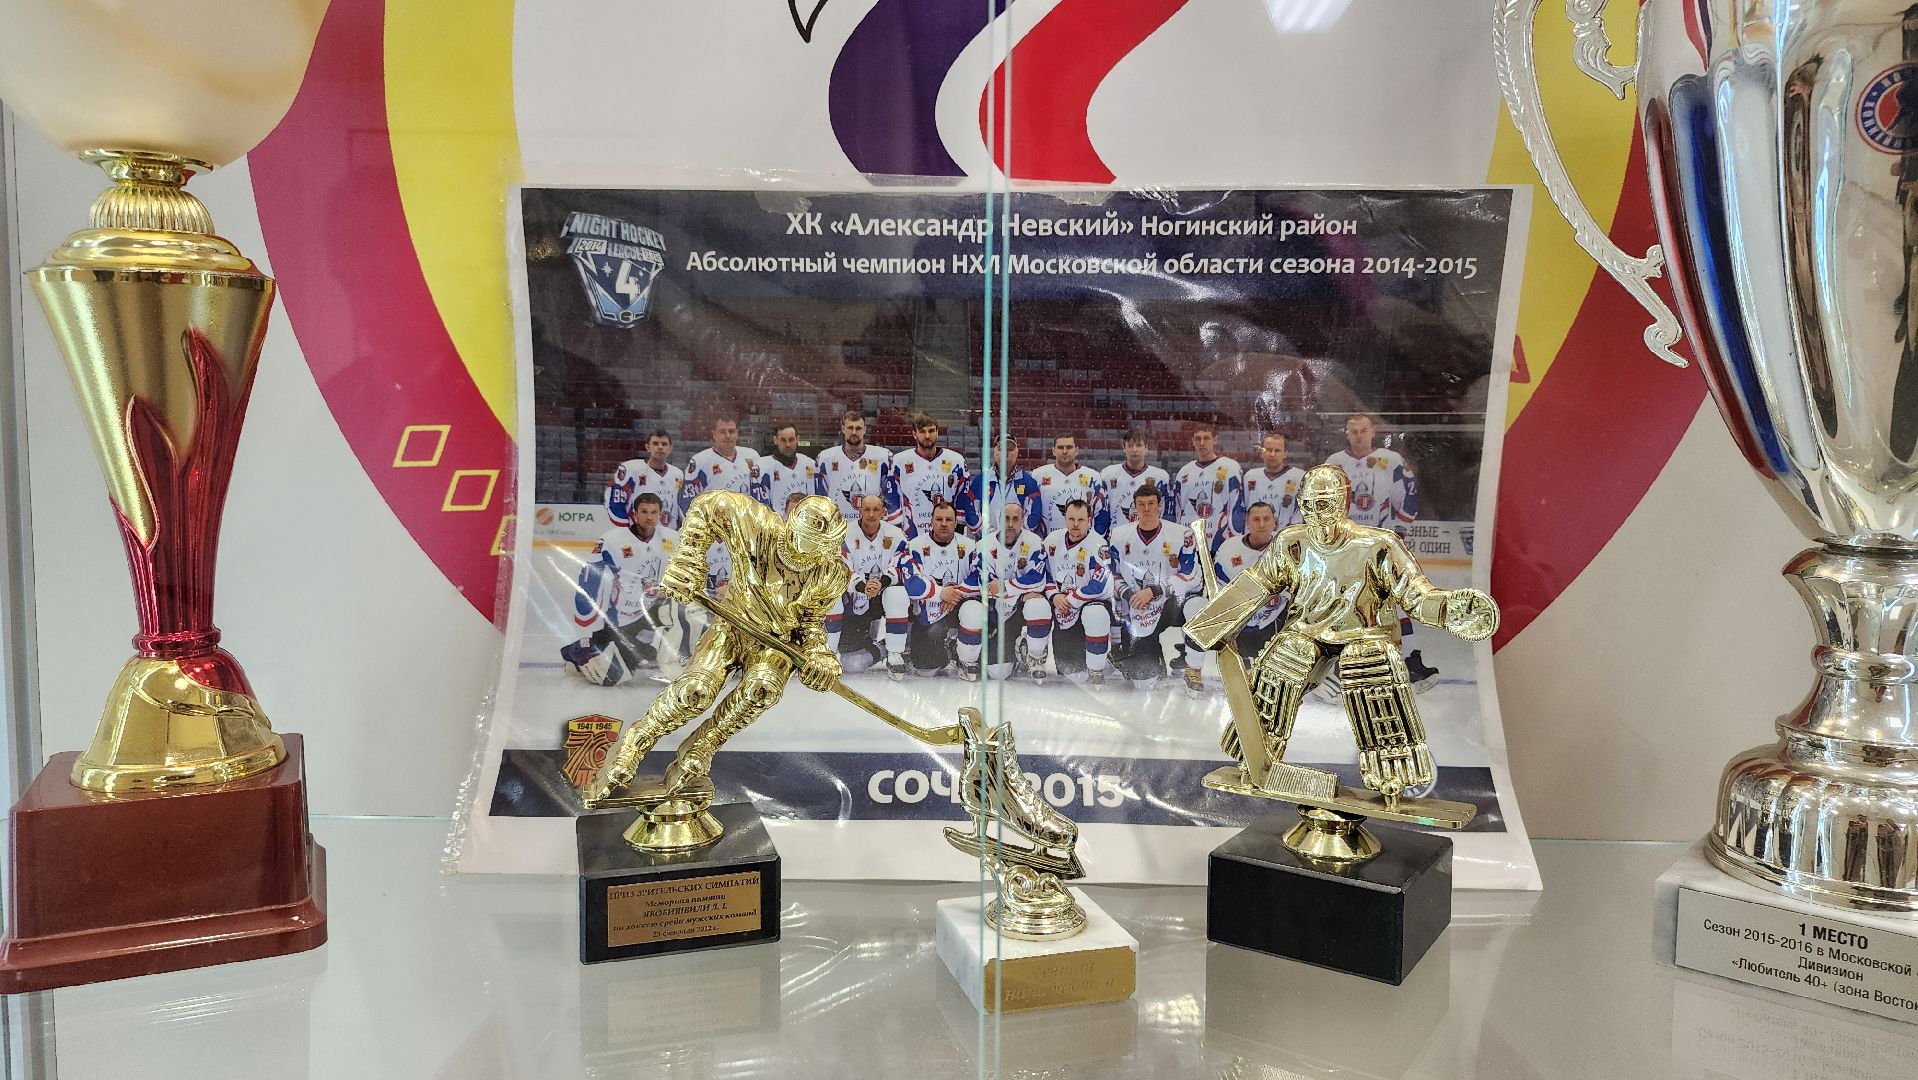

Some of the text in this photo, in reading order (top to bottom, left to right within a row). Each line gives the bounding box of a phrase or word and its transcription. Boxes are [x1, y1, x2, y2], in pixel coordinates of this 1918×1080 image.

[569, 213, 667, 251] NIGHT HOCKEY
[786, 210, 1357, 243] ХК «Александр Невский» Ногинский район
[580, 240, 604, 251] 2014
[686, 251, 1478, 279] Абсолютный чемпион НХЛ Московской области сезона 2014-2015
[558, 511, 595, 523] ЮГРА
[1408, 526, 1438, 538] ЗНЫЕ
[1419, 542, 1451, 554] ОДИН
[574, 770, 597, 786] ЛЕ
[868, 770, 962, 804] СОЧ
[609, 876, 760, 900] ПРИЗ ЗРИТЕЛЬСКИХ СИМПАТИЙ
[660, 918, 685, 929] среди
[1799, 923, 1869, 949] 1 МЕСТО
[1703, 918, 1912, 977] Сезон 2015-2016 в Московской
[1731, 958, 1801, 983] «Любитель
[1804, 974, 1828, 990] 40+
[1833, 981, 1870, 1000] (зона
[1798, 956, 1864, 982] Дивизион
